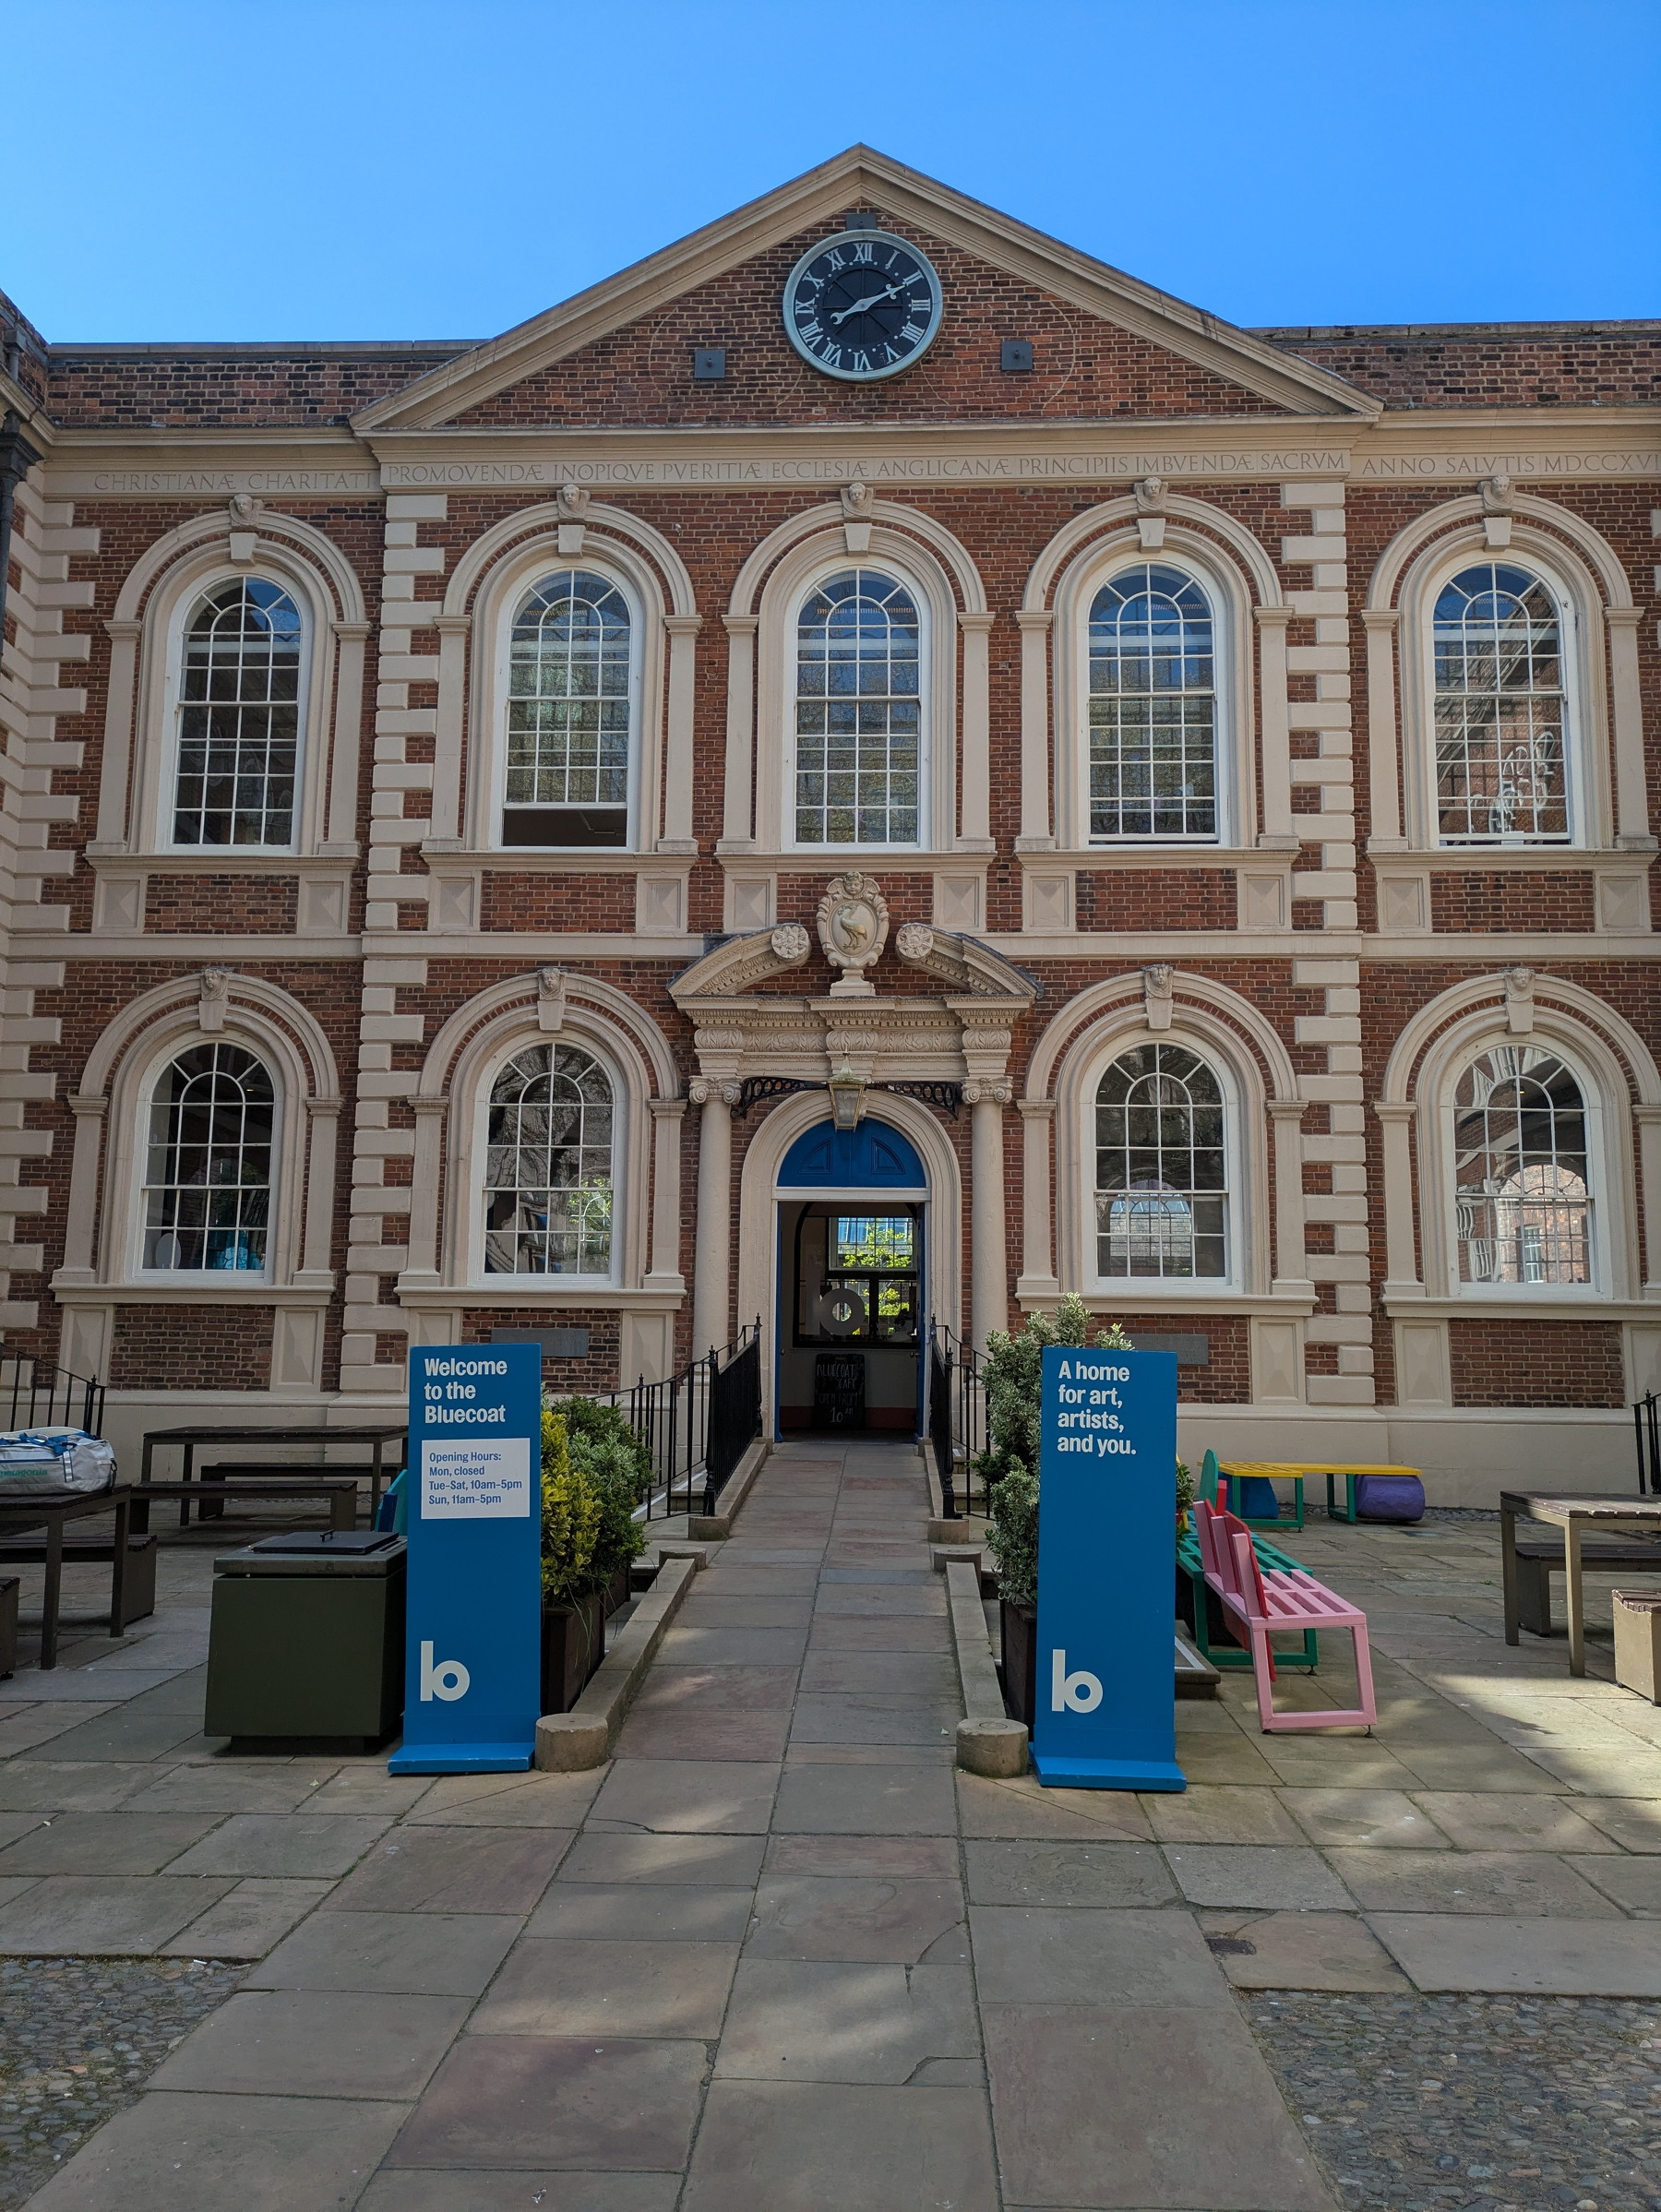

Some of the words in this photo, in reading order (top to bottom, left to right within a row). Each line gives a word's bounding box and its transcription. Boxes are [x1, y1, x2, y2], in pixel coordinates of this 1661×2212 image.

[823, 248, 846, 271] XI
[853, 243, 874, 262] XII
[885, 250, 900, 269] I
[802, 270, 824, 290] X
[795, 297, 816, 316] IX
[911, 298, 931, 313] III
[798, 320, 824, 351] VIII
[900, 321, 926, 345] IIII
[819, 341, 843, 368] VII
[852, 352, 874, 371] VI
[388, 462, 544, 483] PROMOVENDÆ
[553, 463, 655, 483] INOPIQVE
[663, 462, 763, 480] PVERITIÆ
[771, 460, 871, 479] ECCLESIÆ
[876, 459, 1012, 478] ANGLICANÆ
[1020, 456, 1129, 474] PRINCIPIIS
[1135, 454, 1254, 473] IMBVENDÆ
[1260, 452, 1345, 472] SACRVM
[1362, 457, 1436, 475] ANNO
[1446, 455, 1535, 474] SALVTIS
[93, 473, 237, 491] CHRISTIANÆ
[247, 472, 372, 490] CHARITATI
[424, 1357, 508, 1376] Welcome
[817, 1364, 856, 1378] BLUECOAT
[1058, 1360, 1072, 1380] A
[1075, 1361, 1130, 1381] home
[424, 1382, 443, 1401] to
[446, 1381, 476, 1400] the
[819, 1393, 836, 1404] OPEN
[838, 1392, 858, 1406] FROM
[1058, 1384, 1086, 1404] for
[1089, 1387, 1123, 1408] art,
[424, 1405, 507, 1424] Bluecoat
[829, 1406, 843, 1423] 10
[1058, 1408, 1124, 1433] artists,
[1058, 1434, 1093, 1453] and
[1097, 1439, 1137, 1457] you.
[429, 1452, 469, 1464] Opening
[471, 1452, 502, 1461] Hours:
[429, 1466, 452, 1477] Mon,
[454, 1465, 485, 1476] closed
[428, 1494, 450, 1506] Sun,
[420, 1640, 471, 1702] b
[1051, 1648, 1104, 1714] b
